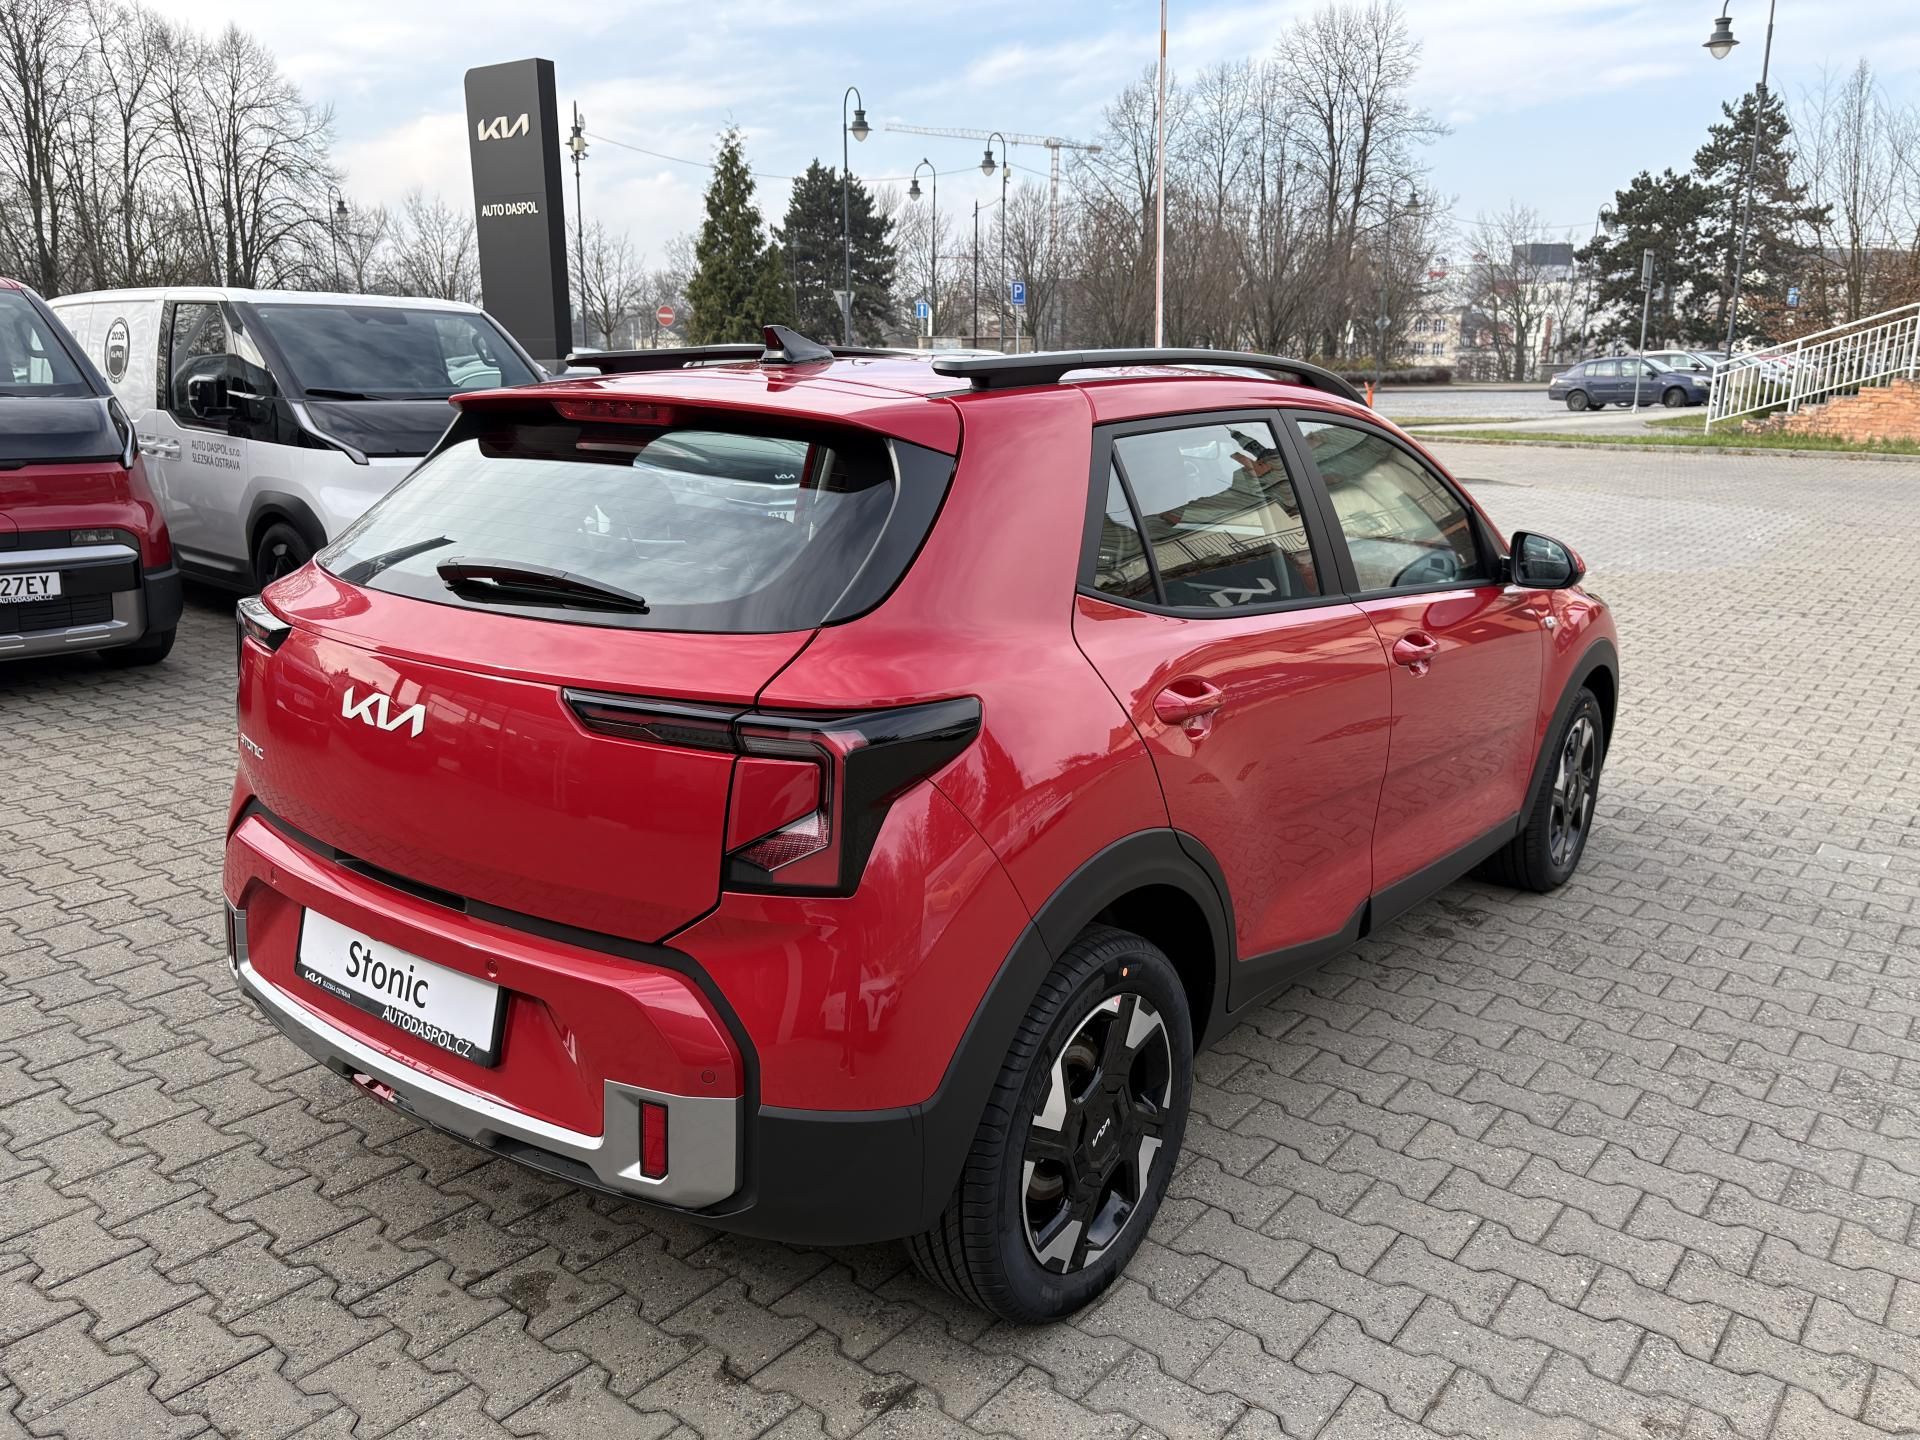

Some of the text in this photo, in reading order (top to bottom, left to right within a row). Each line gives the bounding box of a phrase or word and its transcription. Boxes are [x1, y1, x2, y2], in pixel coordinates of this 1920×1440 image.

[477, 113, 530, 141] KIA
[481, 201, 539, 217] AUTO DASPOL
[1014, 284, 1023, 298] P
[111, 331, 125, 341] 2026
[191, 440, 206, 452] AUTO
[206, 442, 228, 455] DASPOL
[214, 456, 241, 472] OSTRAVA
[0, 575, 50, 596] 27EY
[341, 685, 427, 738] KIA
[346, 940, 427, 1008] Stonic
[382, 1006, 472, 1058] AUTODASPOL.CZ
